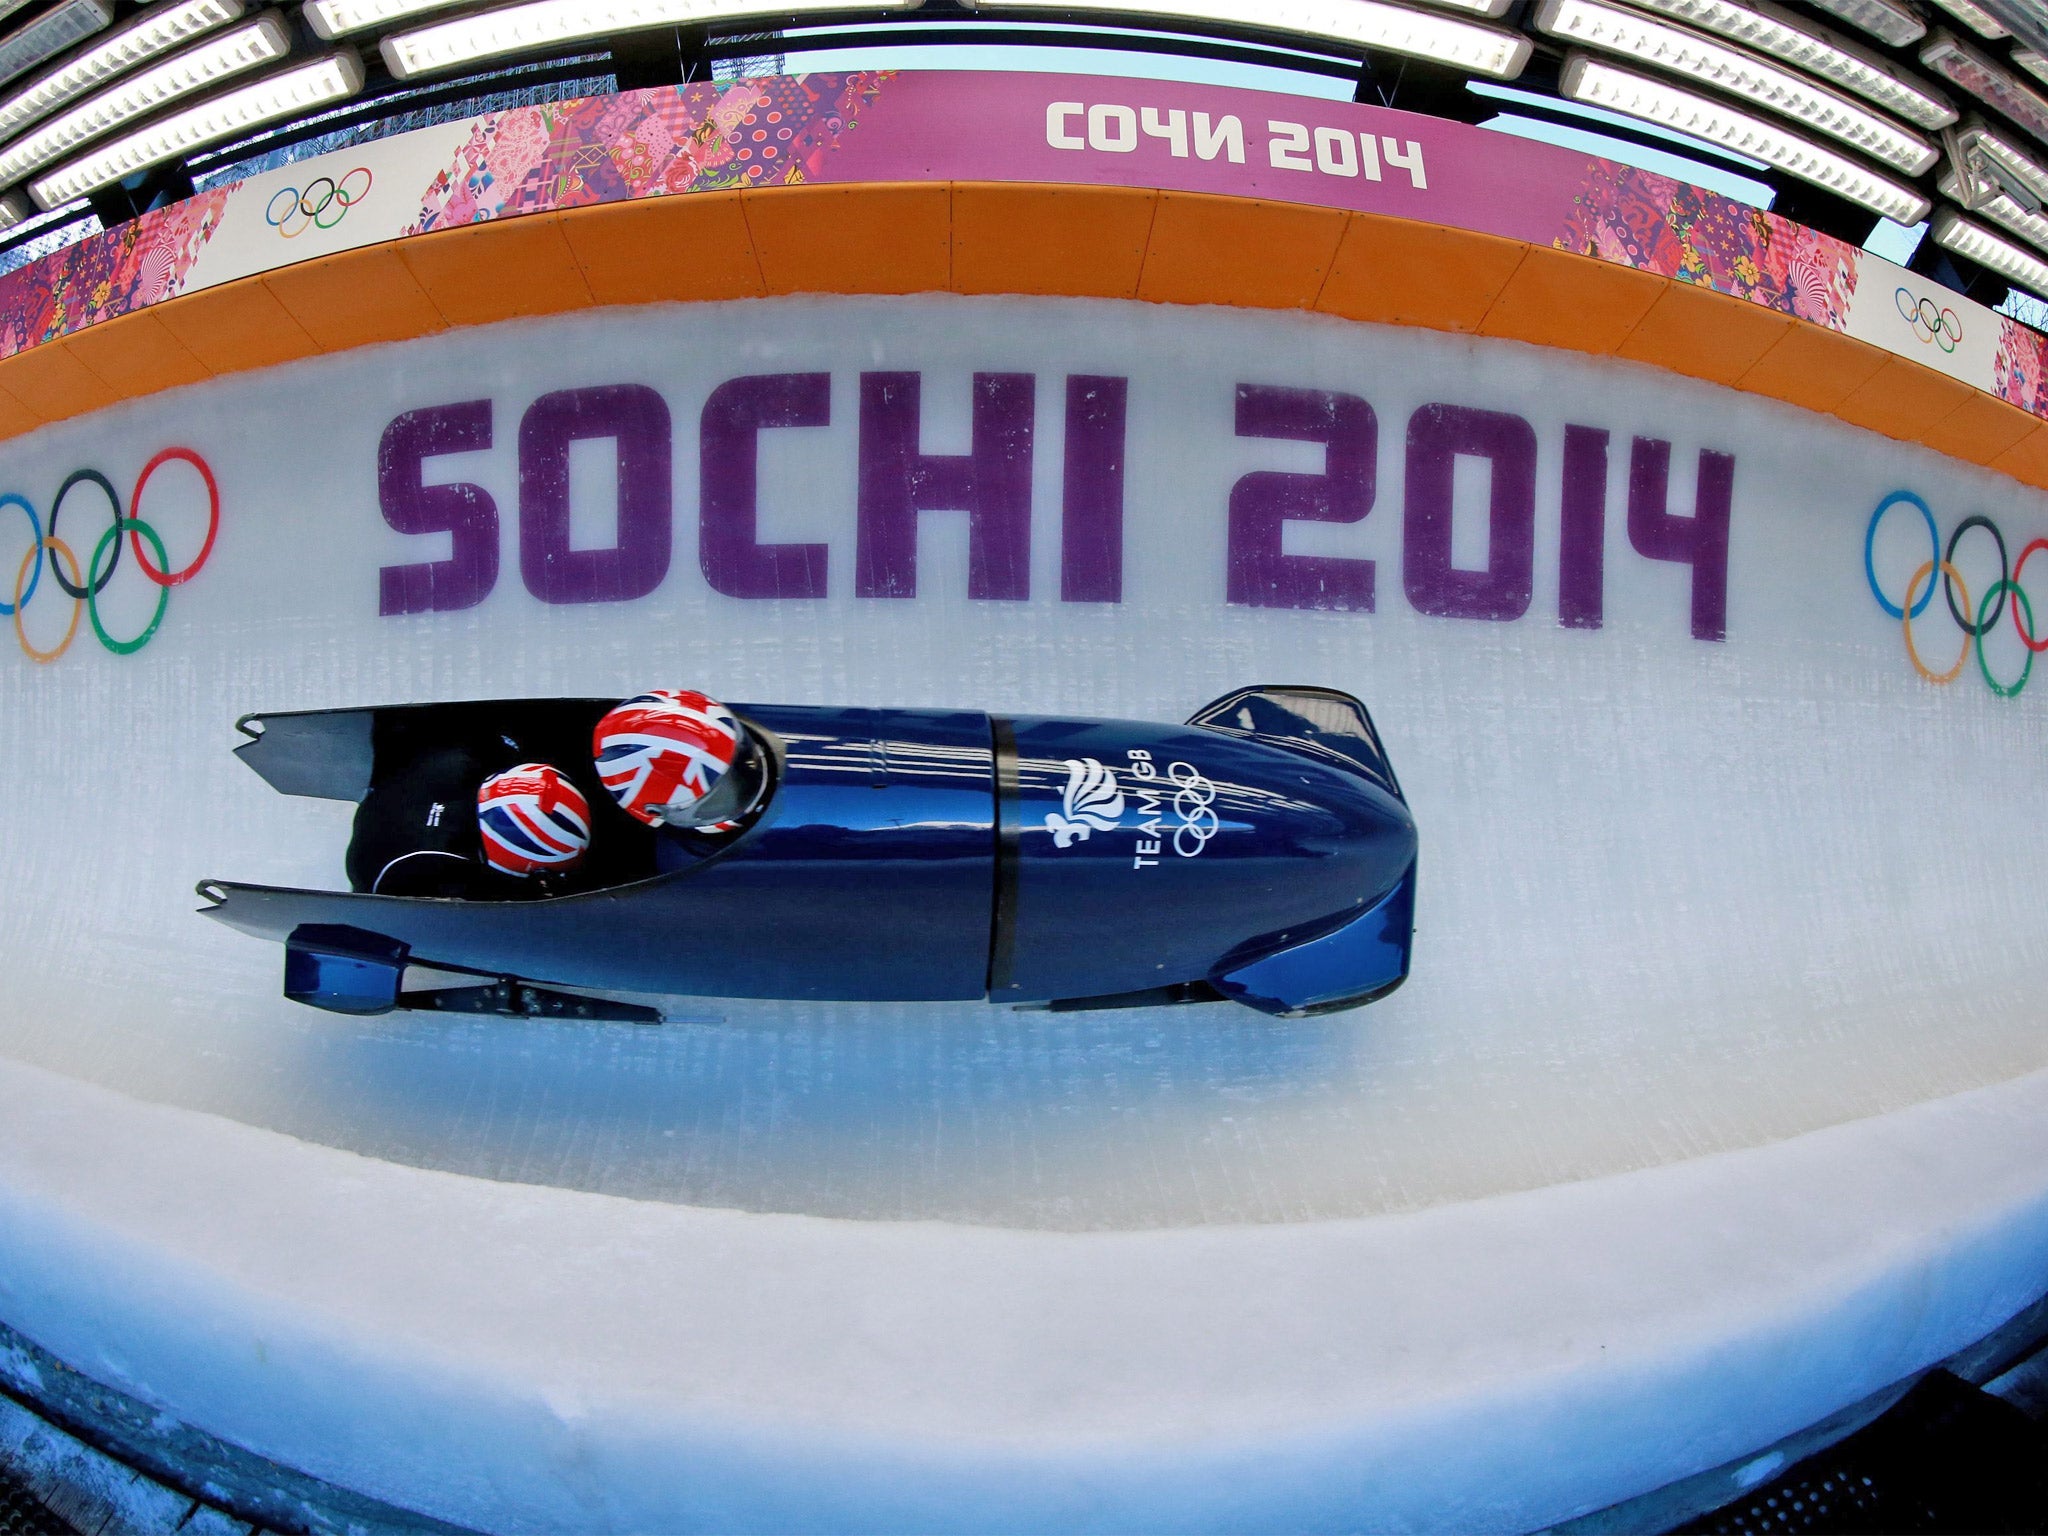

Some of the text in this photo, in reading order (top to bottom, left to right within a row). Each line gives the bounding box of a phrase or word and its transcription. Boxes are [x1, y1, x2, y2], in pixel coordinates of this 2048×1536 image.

[1046, 101, 1428, 190] СОЧИ 2014
[378, 371, 1736, 642] SOCHI 2014
[1126, 749, 1162, 870] TEAM GB
